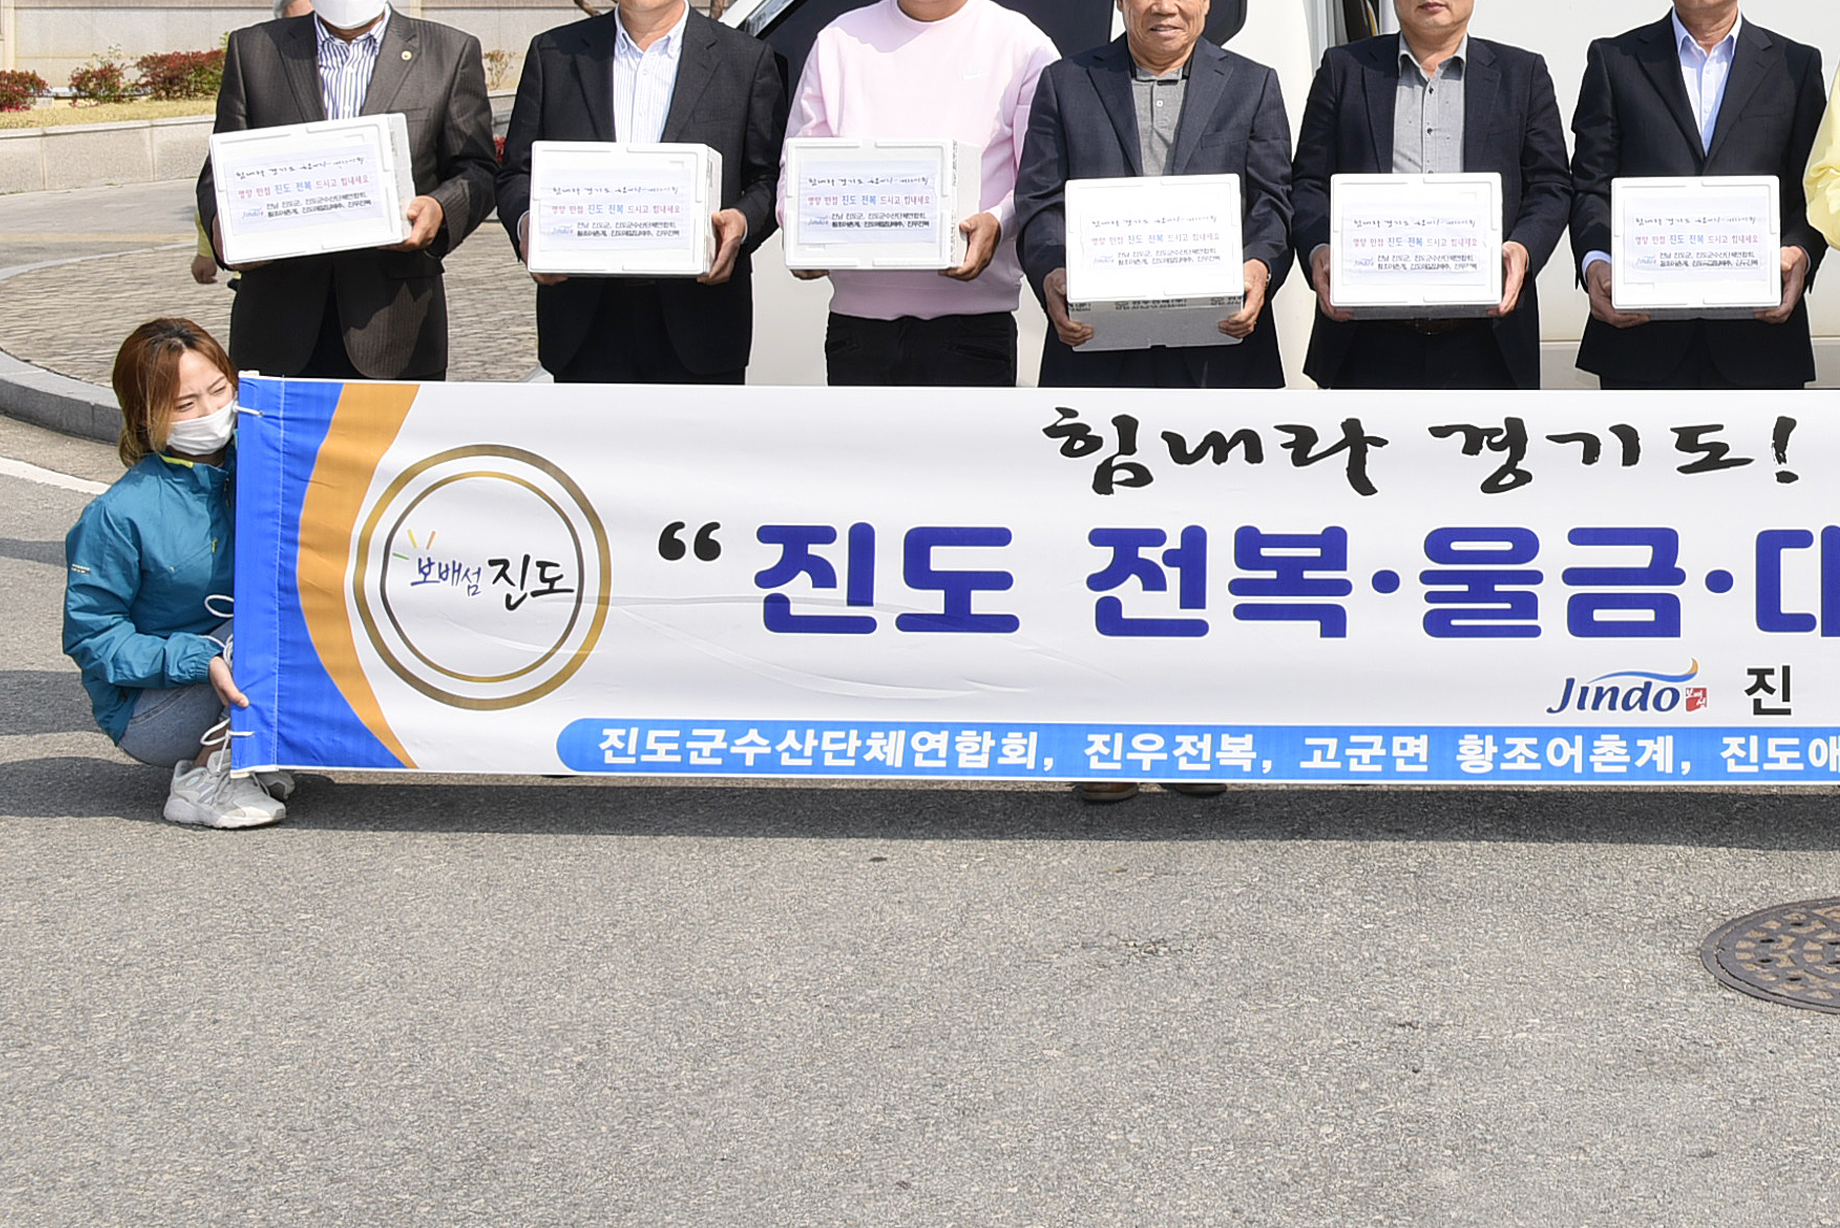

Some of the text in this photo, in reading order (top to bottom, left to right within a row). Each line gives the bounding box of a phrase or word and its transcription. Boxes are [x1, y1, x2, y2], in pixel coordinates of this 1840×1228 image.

[273, 182, 292, 195] 진도
[314, 177, 337, 189] 드시고
[1042, 407, 1389, 497] 힘내라
[1428, 416, 1799, 494] 경기도!
[410, 553, 576, 611] 보배섬 진도
[1546, 677, 1681, 714] Jindo
[599, 727, 1054, 771] 진도군수산단체연합회,
[1083, 732, 1273, 775] 진우전복,
[1299, 734, 1429, 773] 고군면
[1455, 733, 1691, 776] 황조어촌계,
